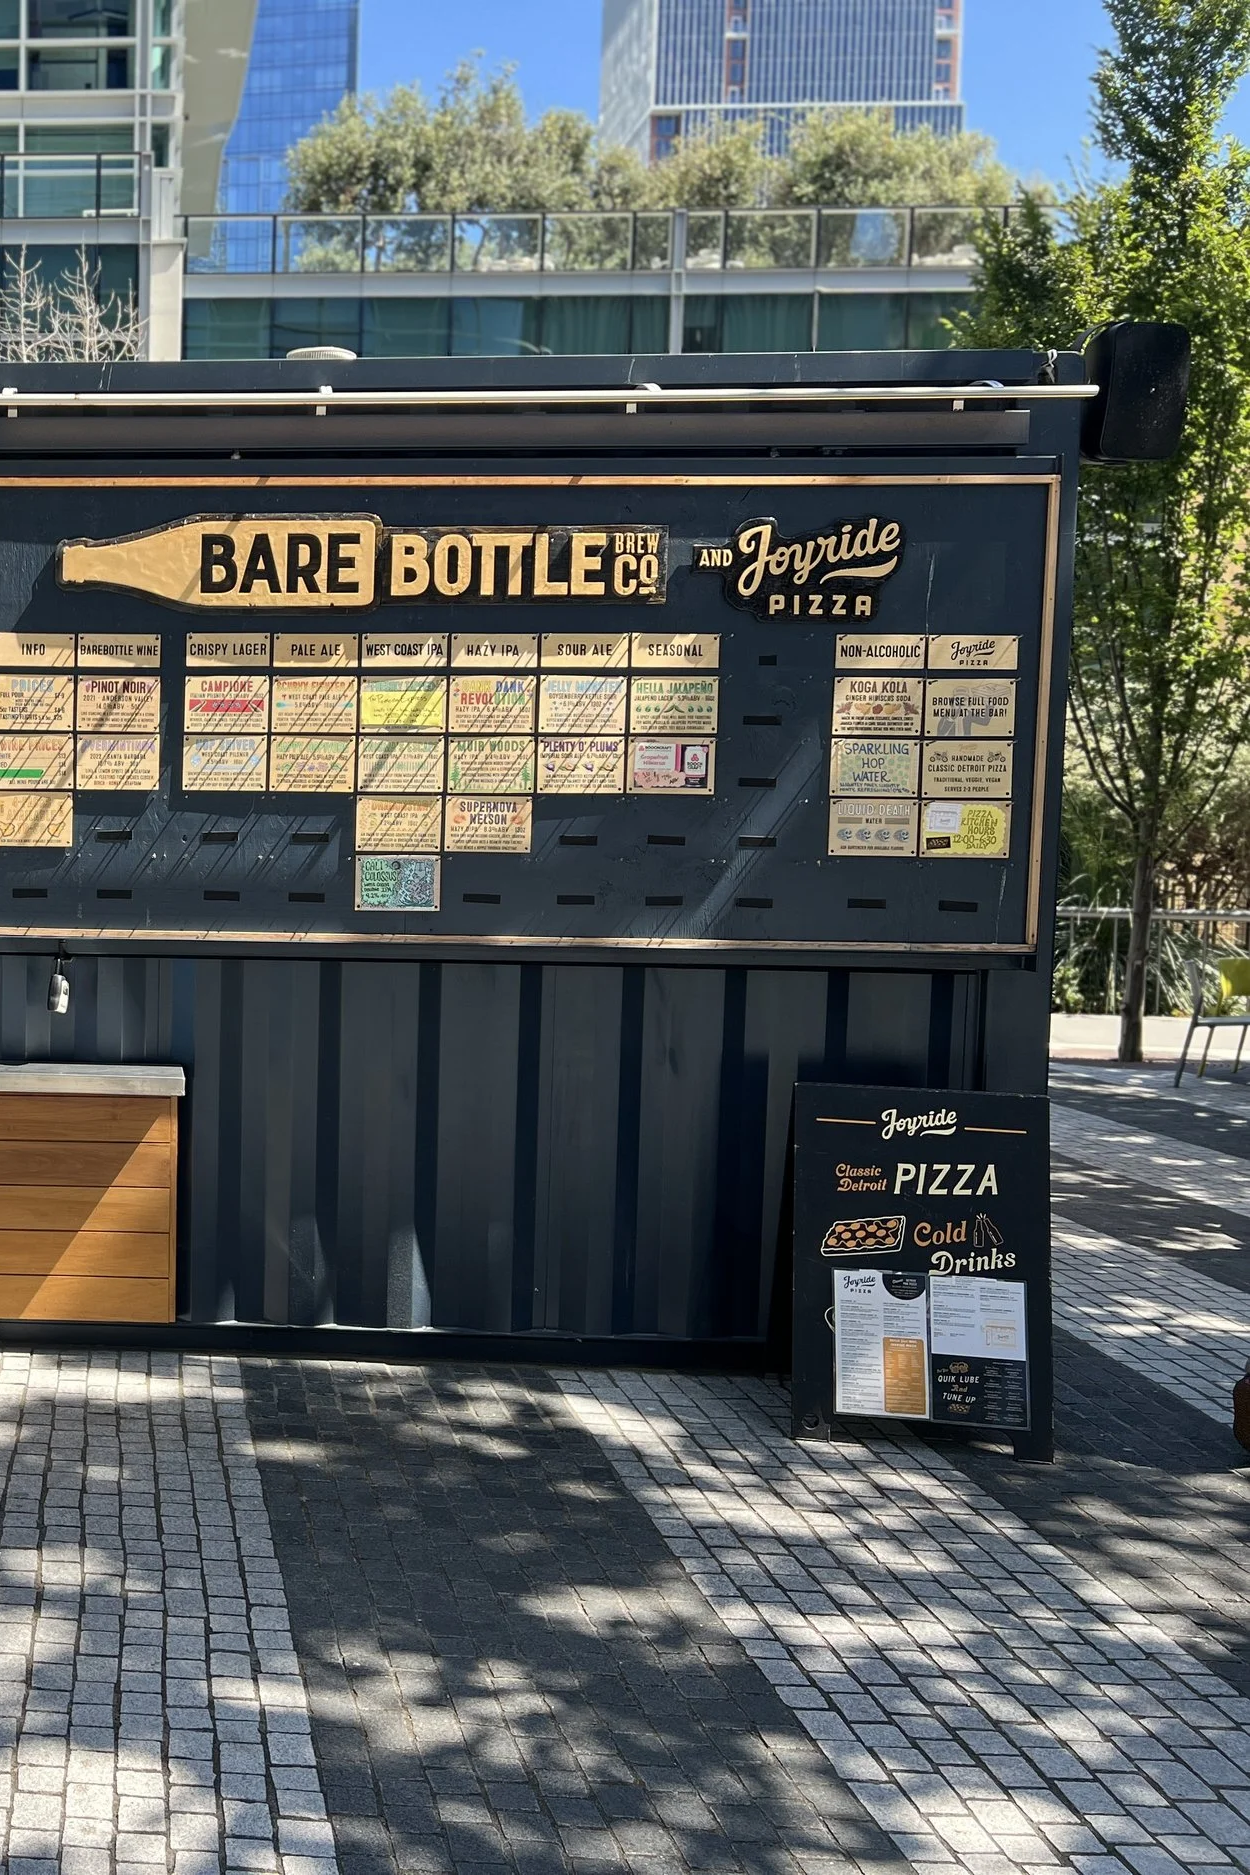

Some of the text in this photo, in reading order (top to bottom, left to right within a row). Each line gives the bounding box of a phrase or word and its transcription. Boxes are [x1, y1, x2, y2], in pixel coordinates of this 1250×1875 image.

[615, 532, 660, 554] BREW
[699, 548, 732, 568] AND
[737, 518, 900, 597] Joyride
[199, 532, 608, 597] BARE BOTTLE
[769, 594, 872, 616] PIZZA
[21, 643, 46, 656] INFO
[80, 644, 159, 656] BAREBOTTLE WINE
[189, 643, 267, 656] CRISPY LAGER
[290, 644, 341, 656] PALE ALE
[366, 644, 444, 656] WEST COAST IPA
[466, 644, 520, 657] HAZY IPA
[557, 643, 613, 656] SOUR ALE
[648, 643, 704, 657] SEASONAL
[840, 644, 921, 658] NON-ALCOHOLIC
[950, 640, 996, 660] Joyride
[10, 678, 54, 692] PRICES
[90, 680, 146, 694] PINOT NOIR
[200, 680, 254, 693] CAMPIONE
[496, 680, 524, 693] DANK
[636, 680, 714, 694] HELLA JALAPEÑO
[850, 680, 908, 694] KOGA KOLA
[102, 694, 132, 702] ANDERSON
[460, 693, 526, 705] REVOLUTION
[845, 694, 912, 702] GINGER HIBISCUS SODA
[932, 696, 1010, 706] BROWSE FULL FOOD
[933, 708, 1008, 718] MENU AT THE BAR!
[457, 740, 526, 752] MUIR WOODS
[544, 741, 576, 752] PLENTY
[590, 741, 618, 752] PLUMS
[844, 742, 910, 756] SPARKLING
[861, 758, 886, 770] HOP
[928, 764, 1008, 772] CLASSIC DETROIT PIZZA
[852, 770, 892, 783] WATER
[460, 801, 518, 813] SUPERNOVA
[837, 803, 911, 816] LIQUID DEATH
[470, 814, 508, 825] NELSON
[967, 810, 994, 818] PIZZA
[960, 818, 998, 828] KITCHEN
[967, 826, 996, 836] HOURS
[966, 842, 989, 850] DAILY
[364, 860, 384, 872] CALI
[364, 870, 398, 882] COLOSSUS
[880, 1108, 958, 1140] Joyride
[834, 1162, 882, 1178] Classic
[836, 1178, 888, 1192] Detroit
[892, 1162, 999, 1196] PIZZA
[913, 1220, 968, 1247] Cold
[928, 1248, 1017, 1276] Drinks
[843, 1275, 876, 1289] Joyride
[937, 1375, 980, 1384] QUIK LUBE
[942, 1392, 977, 1404] TUNE UP
